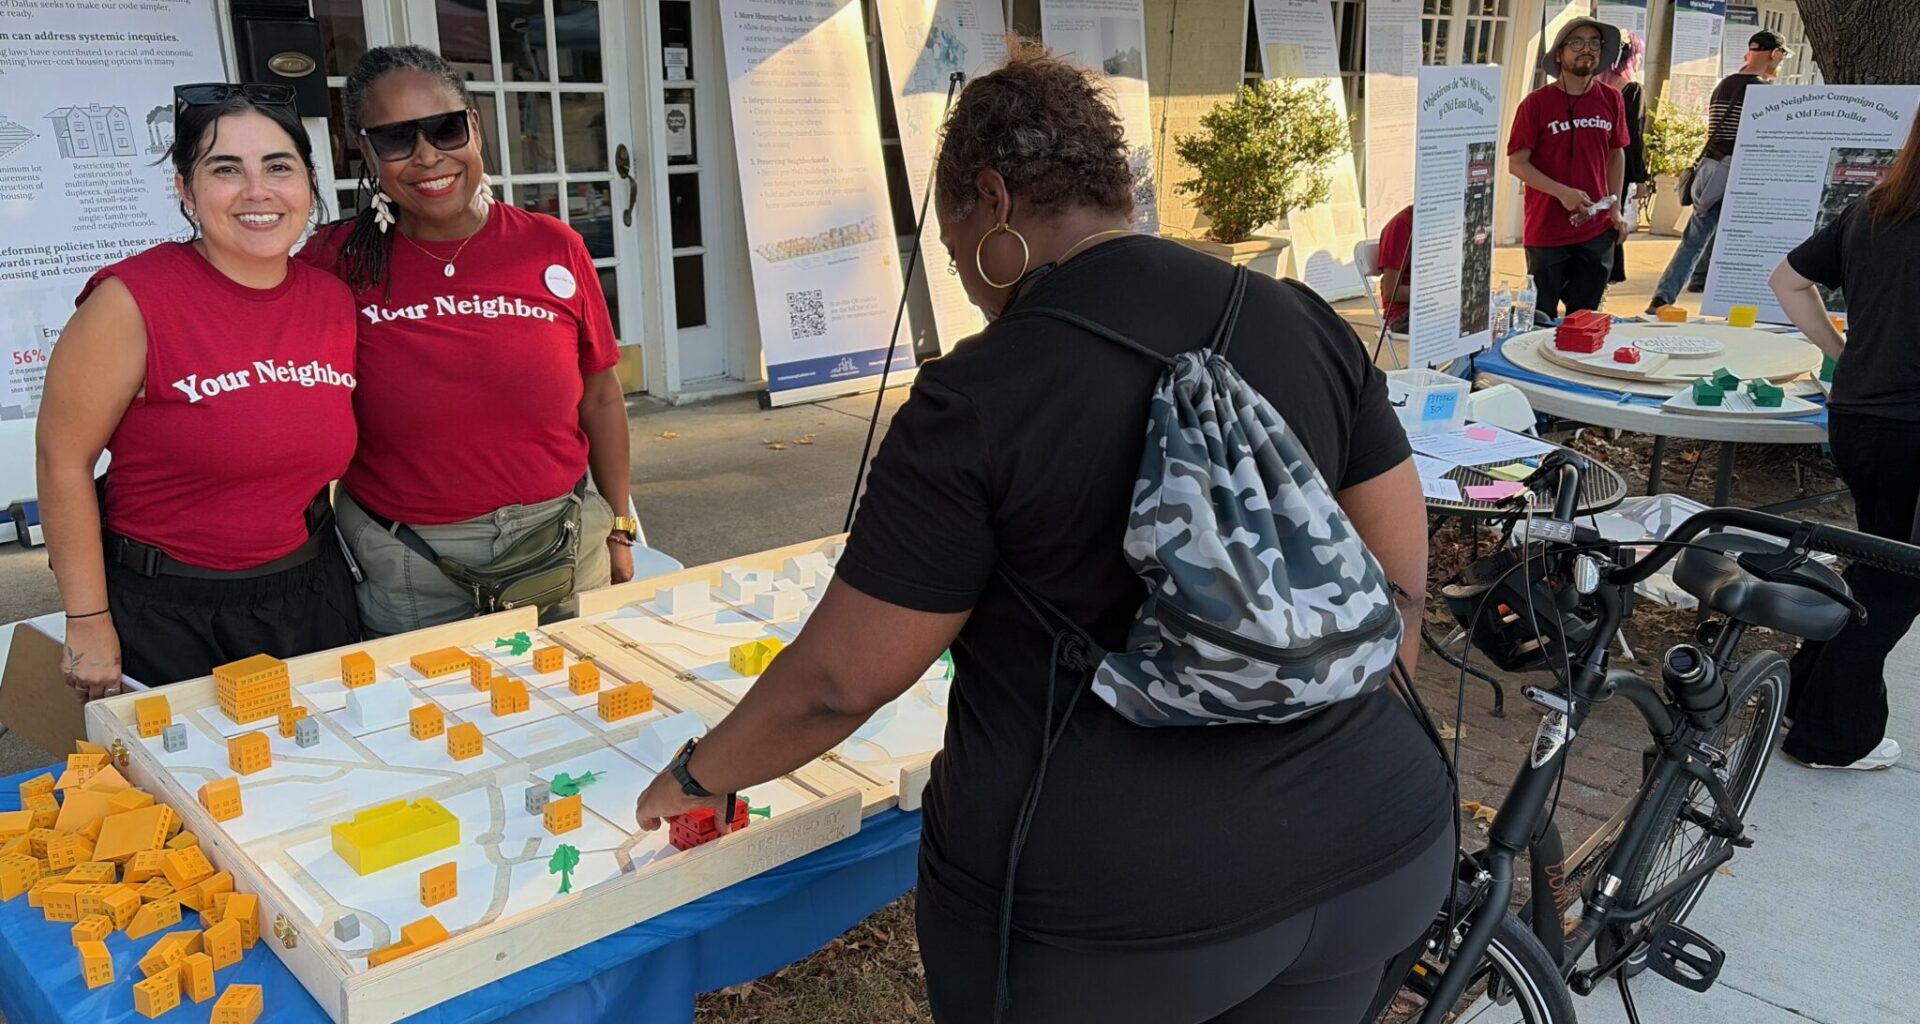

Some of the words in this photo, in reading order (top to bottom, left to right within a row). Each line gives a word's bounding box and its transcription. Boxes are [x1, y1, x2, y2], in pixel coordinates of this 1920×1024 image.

[11, 0, 38, 8] Dallas
[40, 1, 65, 9] seeks
[66, 1, 75, 9] to
[77, 2, 99, 10] make
[6, 9, 34, 19] ready.
[12, 32, 32, 41] can
[34, 31, 76, 41] address
[78, 32, 126, 43] systemic
[127, 32, 180, 43] inequities.
[8, 48, 28, 56] laws
[30, 48, 50, 56] have
[52, 48, 102, 57] contributed
[27, 58, 75, 67] lower-cost
[76, 58, 110, 68] housing
[111, 58, 143, 68] options
[144, 58, 153, 66] in
[154, 59, 175, 68] many
[1452, 77, 1458, 90] de
[1443, 98, 1454, 114] Old
[1454, 97, 1467, 110] East
[1467, 97, 1484, 116] Dallas
[1751, 110, 1765, 121] Be
[1765, 103, 1781, 114] My
[1781, 92, 1826, 108] Neighbor
[1827, 91, 1875, 109] Campaign
[1875, 102, 1901, 121] Goals
[1785, 113, 1794, 121] &
[1795, 108, 1812, 118] Old
[1813, 108, 1836, 118] East
[1836, 109, 1868, 124] Dallas
[1548, 120, 1571, 136] Tu
[1572, 115, 1613, 132] vecino
[30, 165, 43, 173] lot
[73, 163, 114, 171] Restricting
[116, 161, 130, 169] the
[73, 170, 124, 178] construction
[35, 182, 44, 191] of
[64, 178, 109, 188] multifamily
[110, 178, 130, 186] units
[131, 178, 145, 186] like
[65, 187, 103, 197] duplexes,
[79, 197, 95, 205] and
[83, 205, 128, 214] apartments
[128, 204, 138, 212] in
[72, 223, 97, 232] zoned
[53, 241, 96, 254] policies
[96, 238, 117, 250] like
[118, 237, 147, 248] these
[148, 237, 164, 245] are
[33, 255, 63, 266] racial
[65, 252, 102, 266] justice
[103, 250, 123, 261] and
[40, 265, 61, 277] and
[434, 295, 558, 324] Neighbor
[12, 349, 46, 365] 56%
[173, 370, 250, 405] Your
[253, 359, 357, 388] Neighbo
